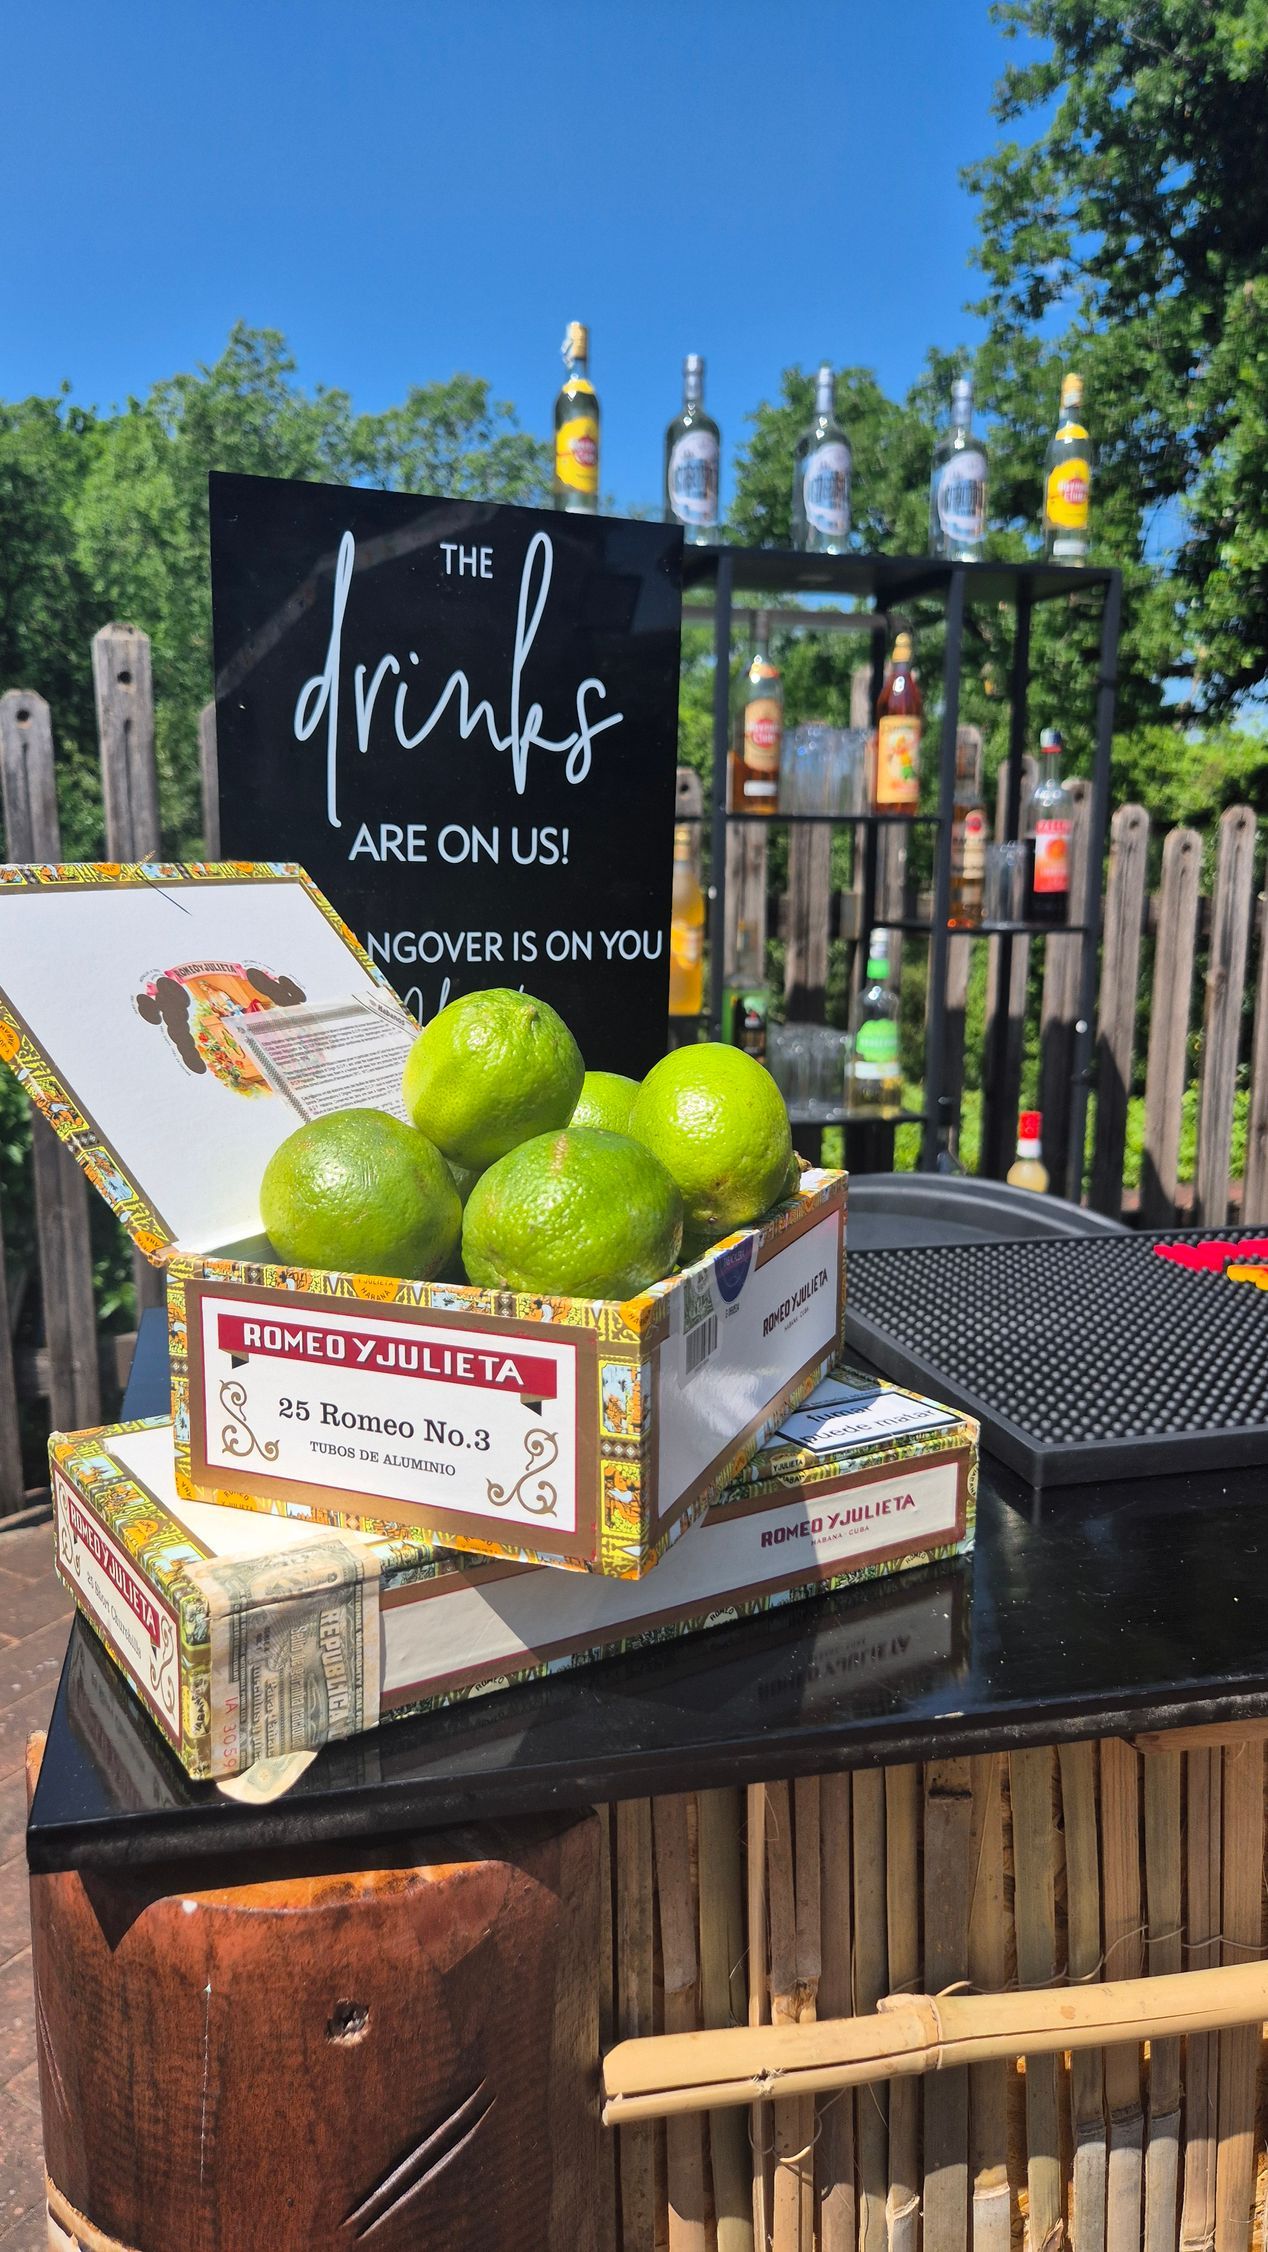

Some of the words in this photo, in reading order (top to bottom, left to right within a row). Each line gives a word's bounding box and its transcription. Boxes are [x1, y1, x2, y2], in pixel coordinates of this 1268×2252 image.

[440, 543, 493, 578] THE
[294, 531, 624, 828] drinks
[348, 824, 428, 863] ARE
[437, 824, 499, 864] ON
[512, 827, 570, 865] US!
[367, 930, 505, 963] NGOVER
[513, 931, 538, 962] IS
[545, 930, 593, 962] ON
[600, 929, 663, 961] YOU
[763, 1298, 790, 1337] ROMEO
[243, 1322, 346, 1361] ROMEO
[278, 1397, 311, 1422] 25
[320, 1402, 415, 1439] Romeo
[424, 1420, 492, 1452] No.3
[800, 1421, 873, 1445] puede
[874, 1409, 936, 1428] matar
[806, 1405, 871, 1423] fumar
[310, 1440, 356, 1459] TUBOS
[359, 1448, 380, 1464] DE
[383, 1453, 456, 1477] ALUMINIO
[71, 1502, 101, 1553] ROMEO
[761, 1517, 822, 1548] ROMEO
[811, 1533, 843, 1546] HABANA
[848, 1525, 870, 1536] CUBA
[320, 1607, 349, 1723] REPUBLICA
[354, 1630, 363, 1687] WARRANTY
[354, 1687, 363, 1709] SEAL
